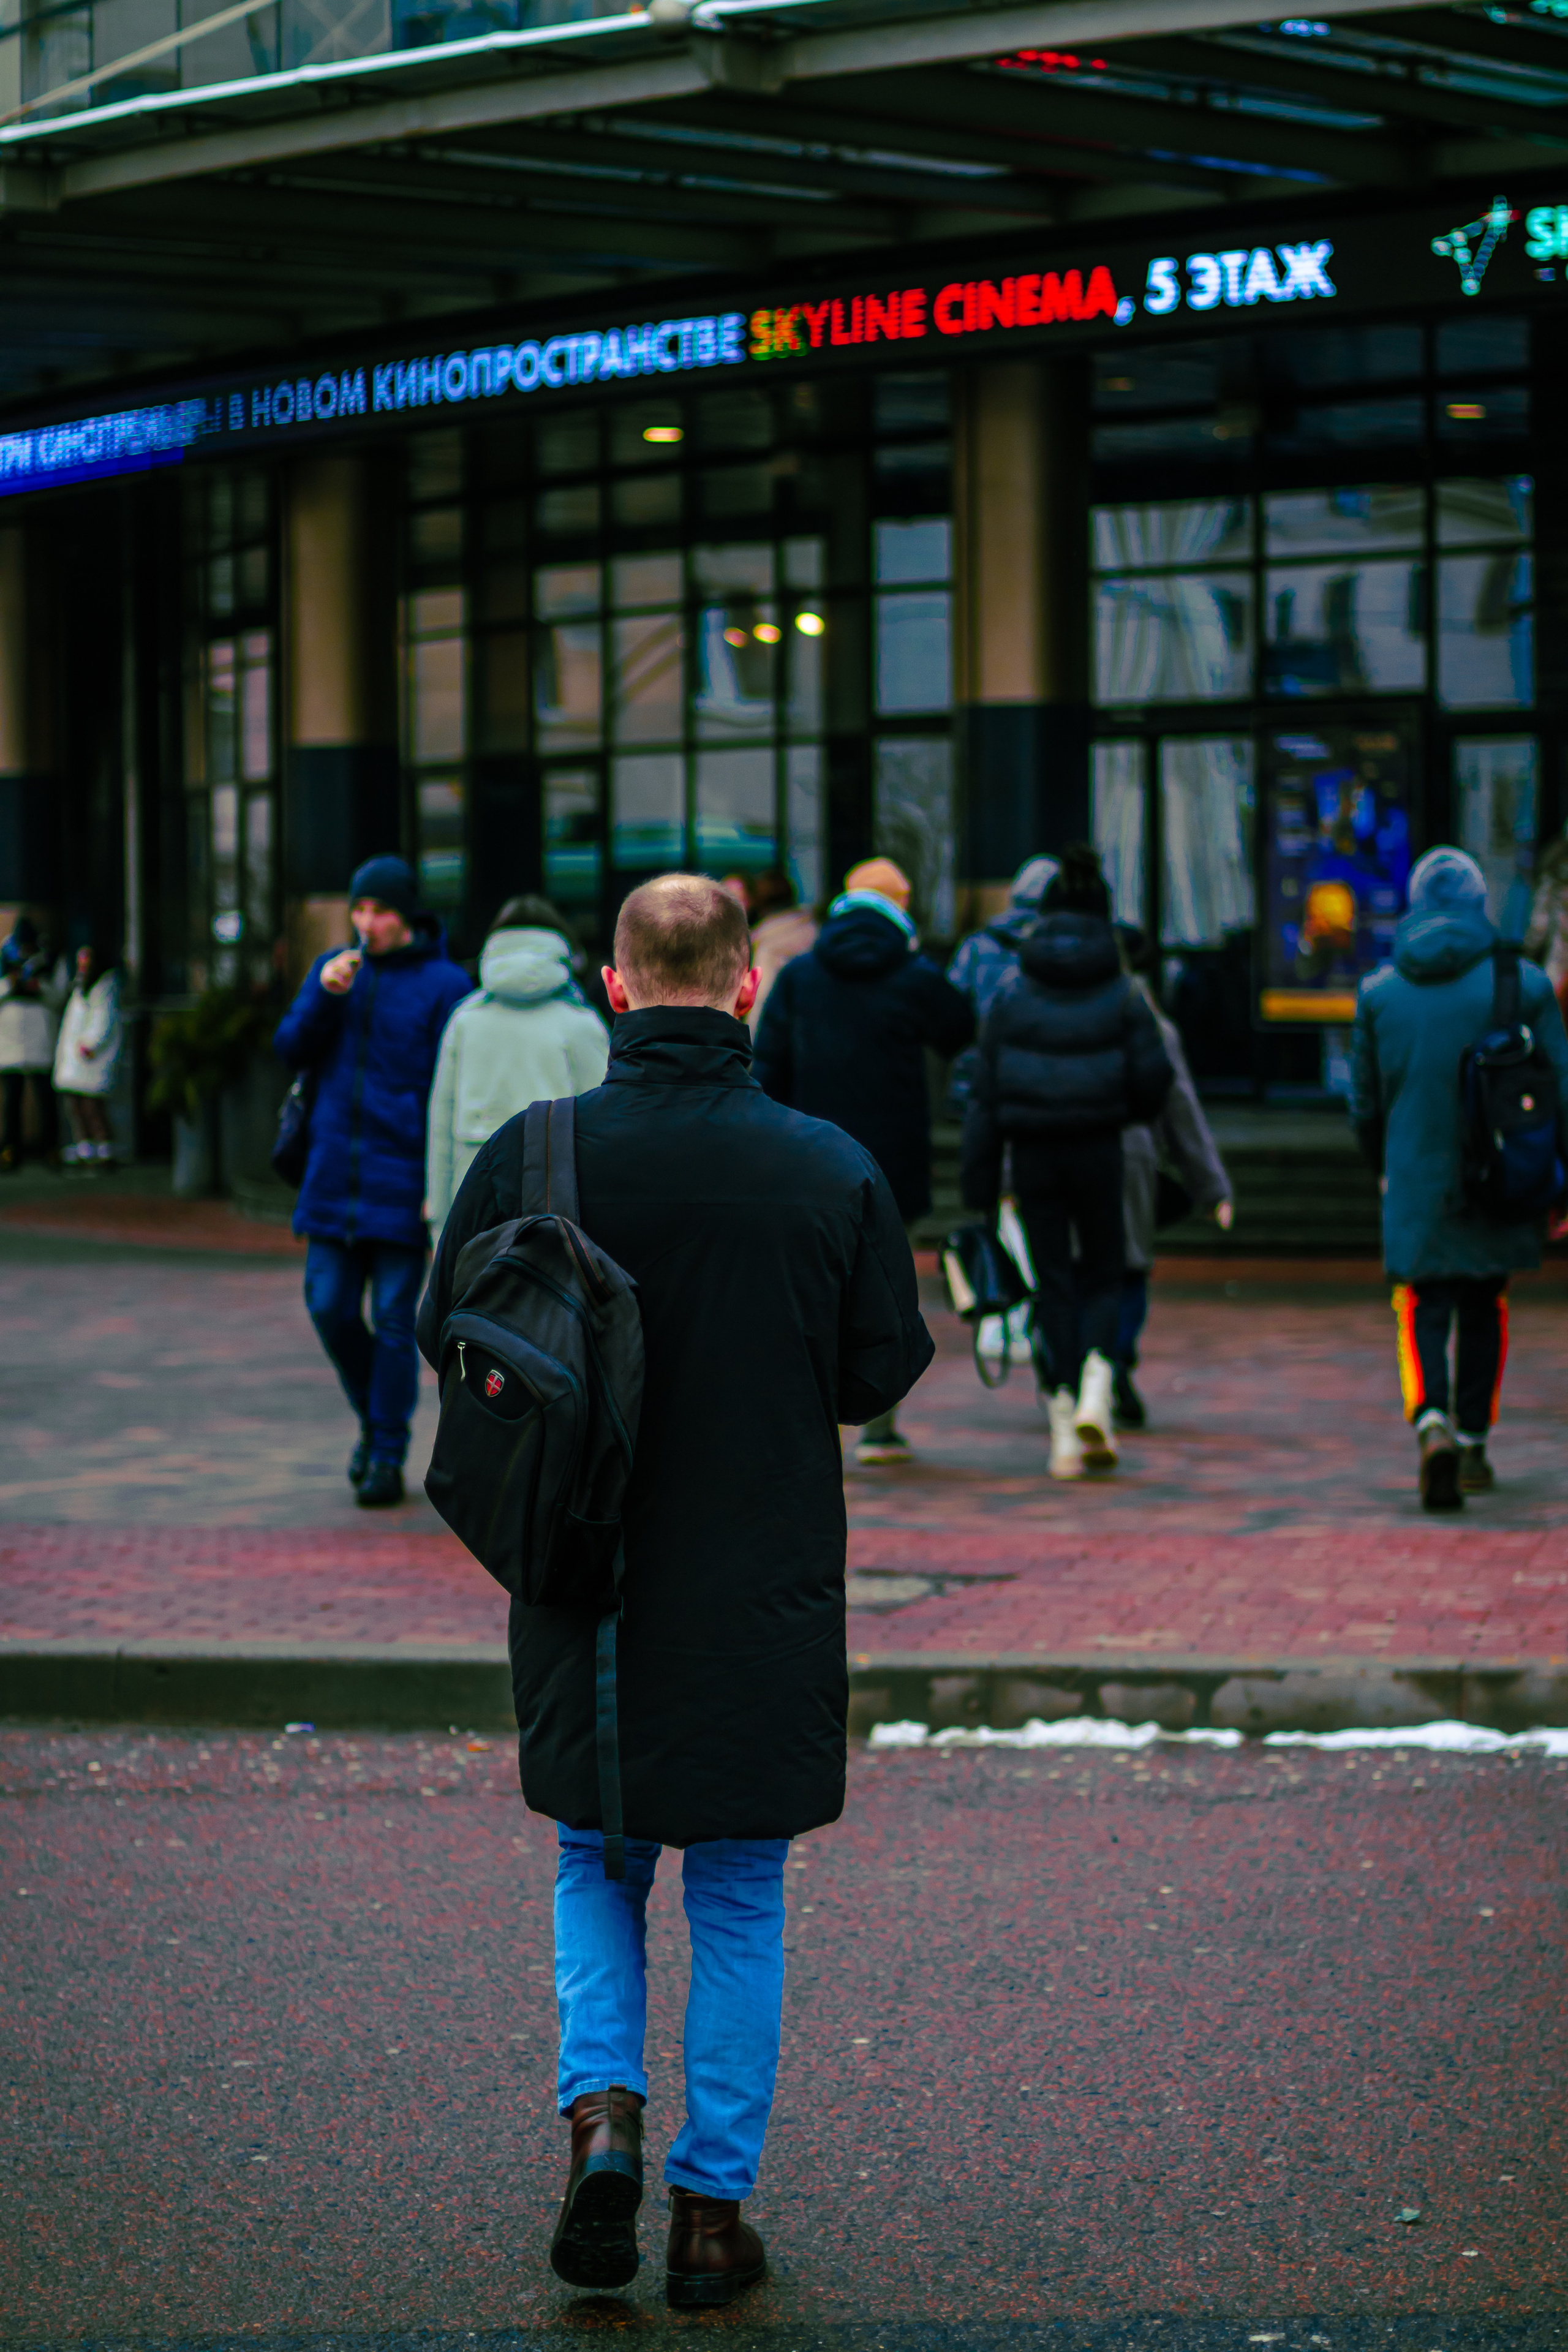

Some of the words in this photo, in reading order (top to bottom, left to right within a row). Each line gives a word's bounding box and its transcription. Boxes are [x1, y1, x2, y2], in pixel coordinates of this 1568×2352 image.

[252, 367, 368, 428] НОВОМ
[372, 312, 746, 412] КИНОПРОСТРАНСТВЕ
[749, 288, 927, 360] SKYLINE
[1143, 257, 1182, 315] 5
[1185, 238, 1337, 311] ЭТАЖ
